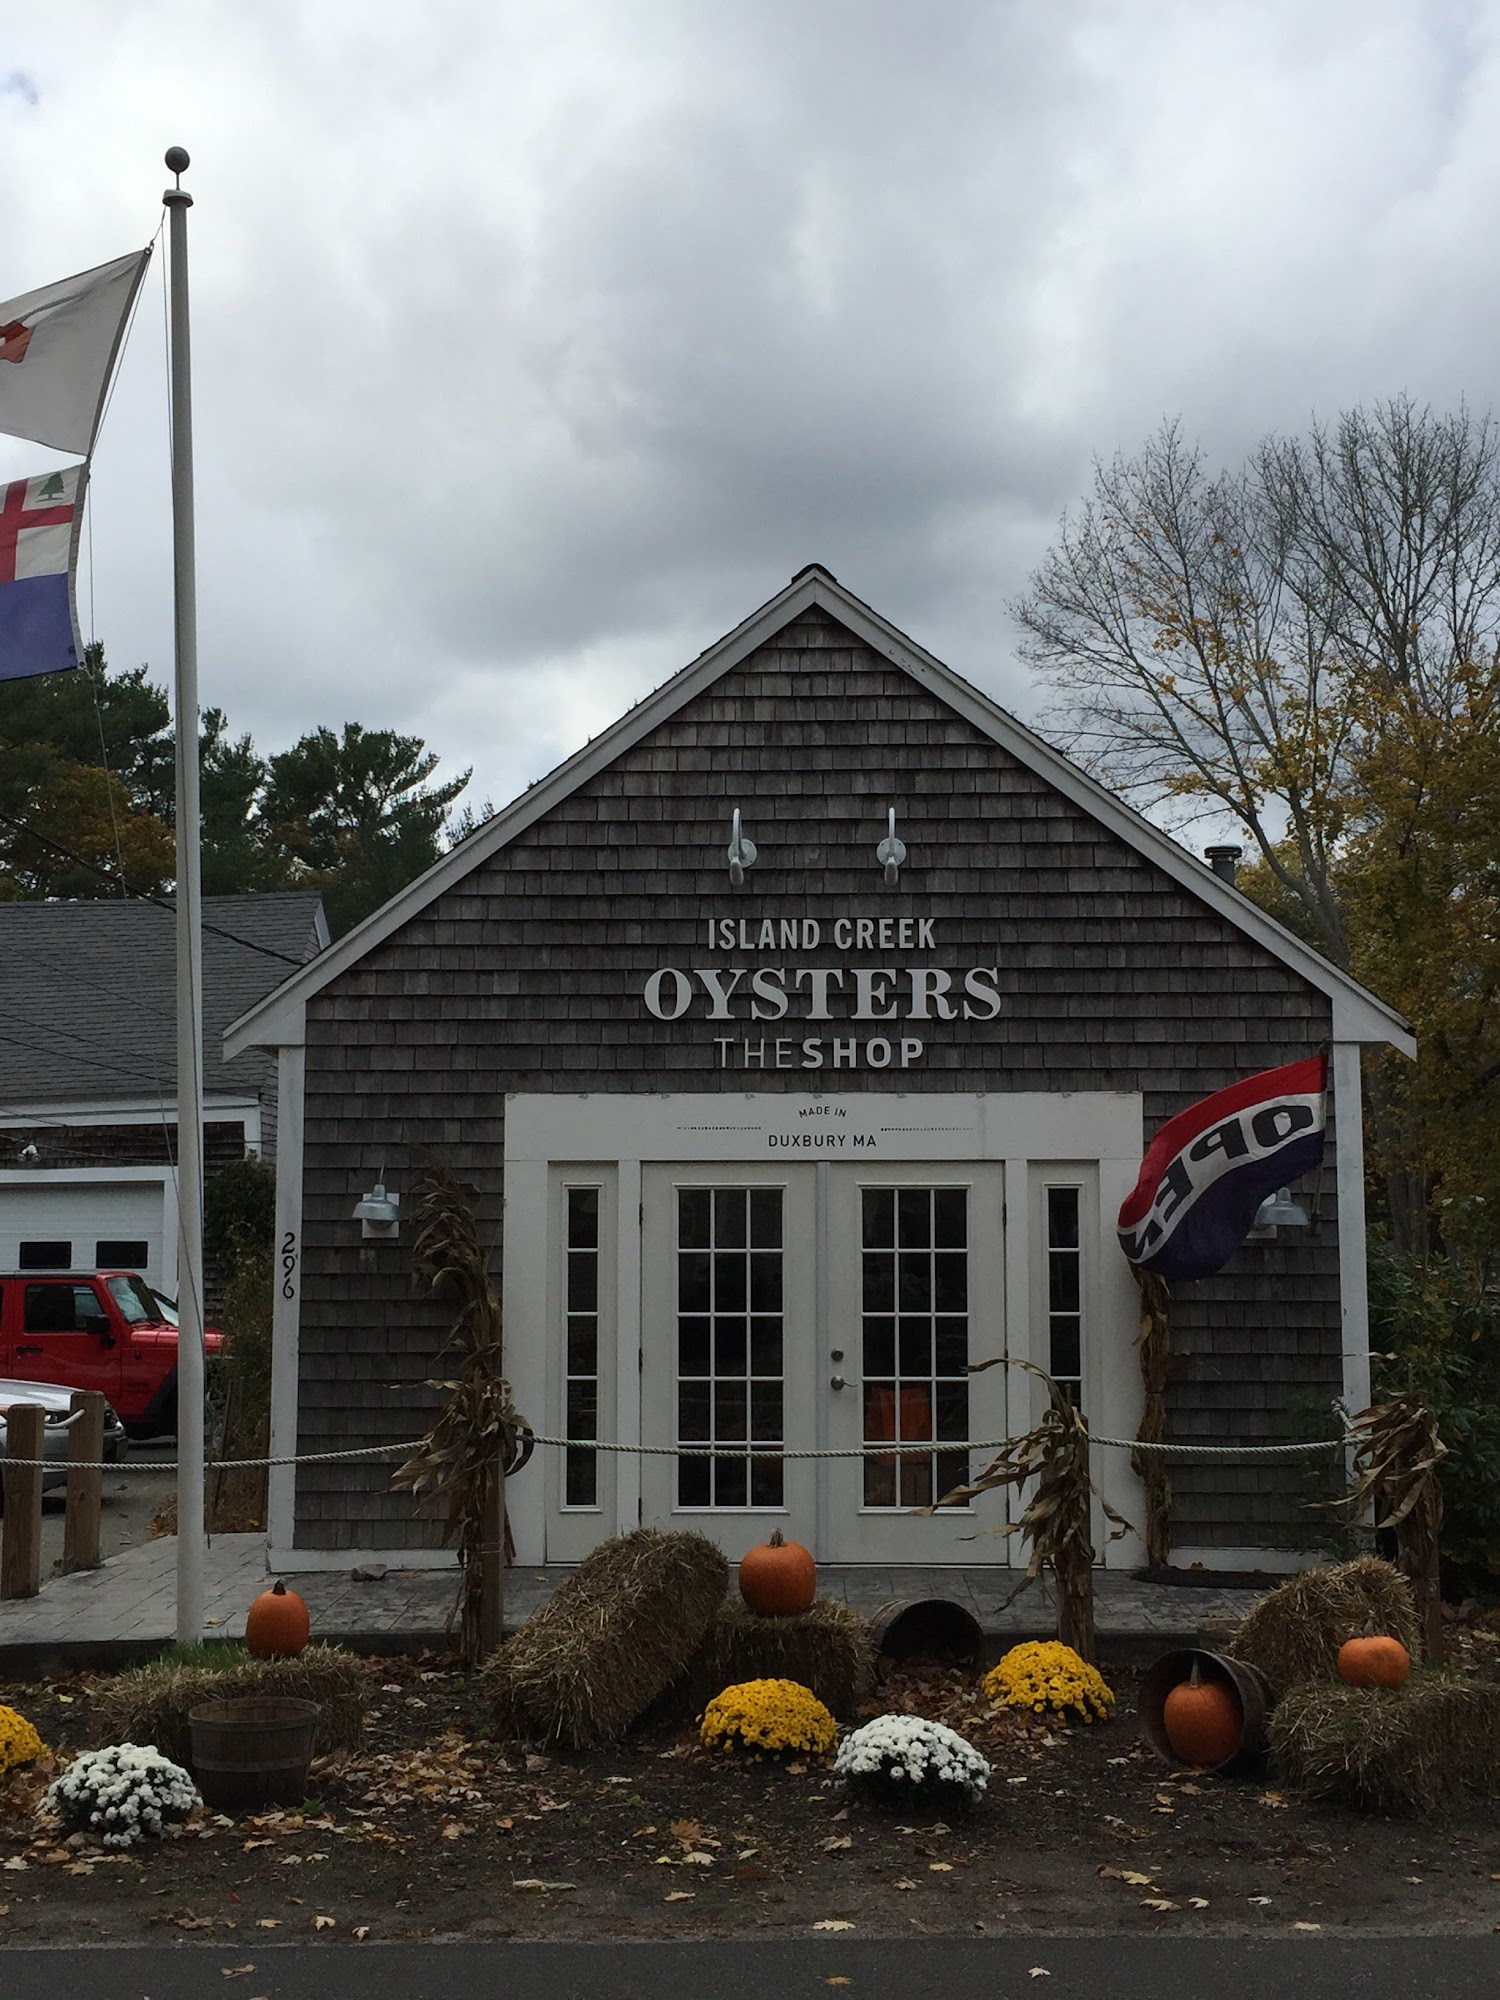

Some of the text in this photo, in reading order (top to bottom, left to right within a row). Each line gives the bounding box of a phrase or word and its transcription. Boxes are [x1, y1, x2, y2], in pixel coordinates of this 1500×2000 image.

[708, 918, 937, 950] ISLAND CREEK
[643, 967, 1002, 1020] OYSTERS
[713, 1037, 924, 1069] THE SHOP
[798, 1106, 847, 1118] MADE IN
[768, 1134, 877, 1148] DUXBURY MA
[281, 1231, 296, 1299] 296
